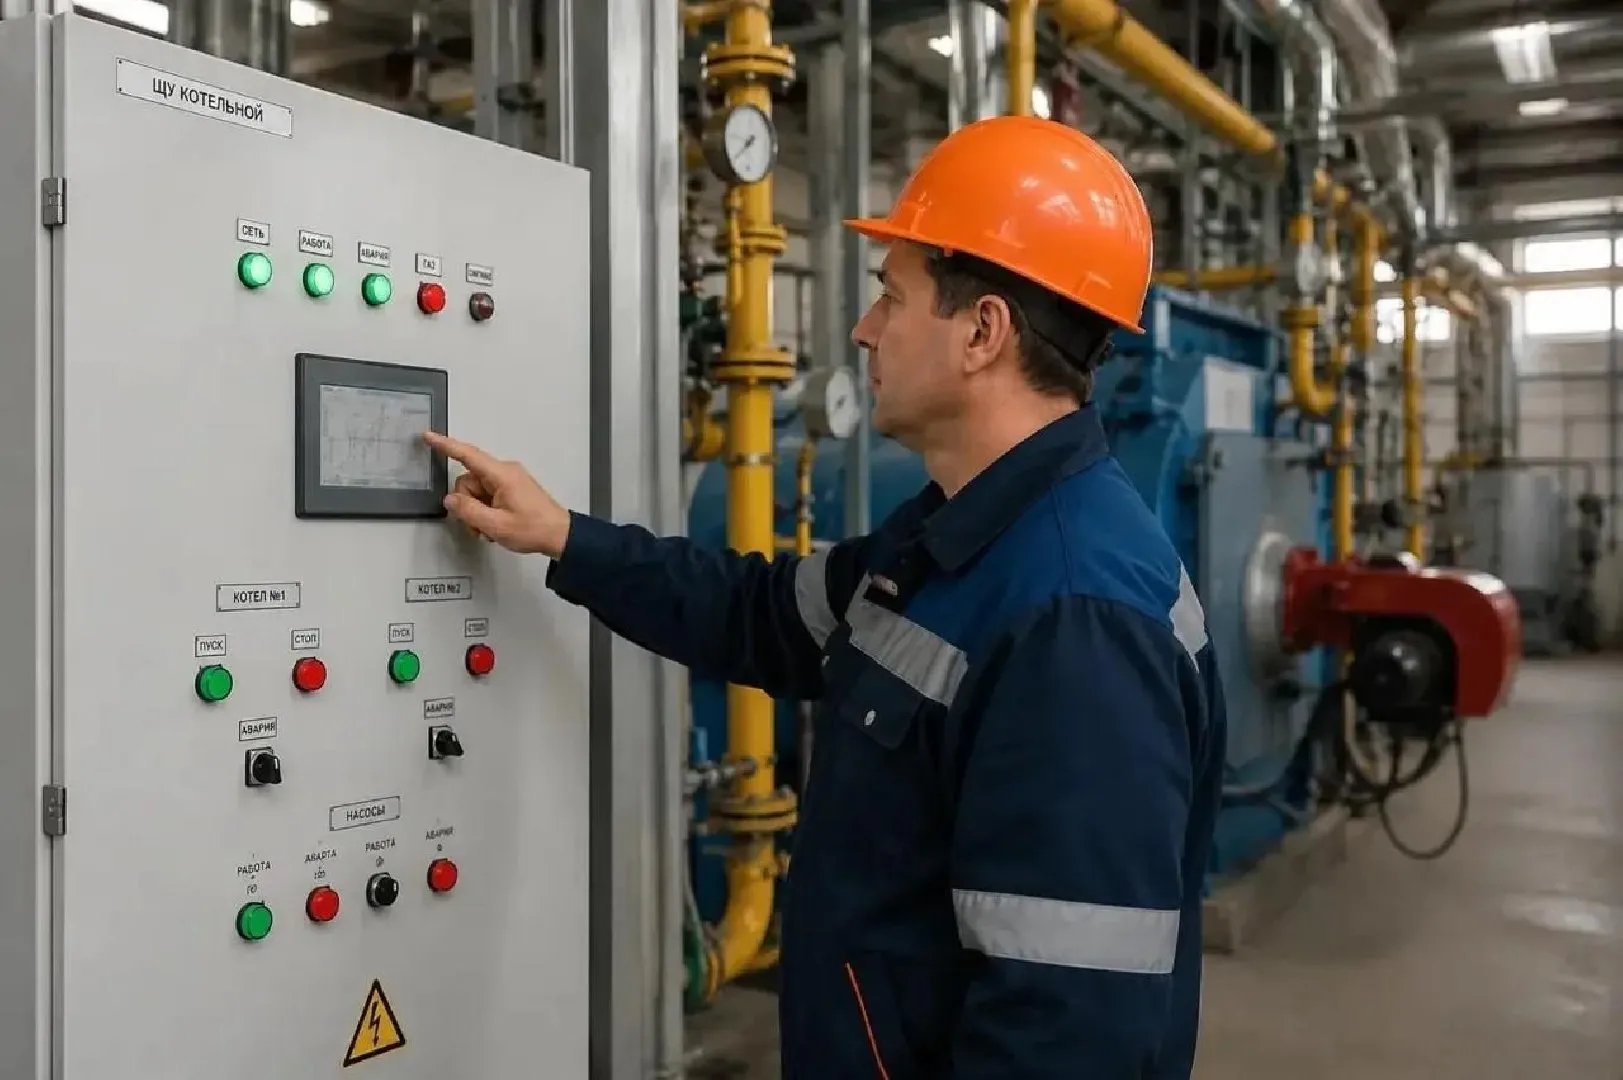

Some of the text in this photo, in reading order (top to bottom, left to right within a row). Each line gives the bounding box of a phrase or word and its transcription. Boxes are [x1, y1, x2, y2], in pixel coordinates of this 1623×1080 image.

[152, 77, 263, 122] ЩУ КОТЕЛЬНОЙ
[242, 224, 264, 239] СЕТЬ
[233, 589, 286, 603] КОТЕЛ №1
[199, 640, 223, 651] ПУСК
[294, 634, 316, 644] СТОП
[346, 805, 386, 822] НАСОСЫ
